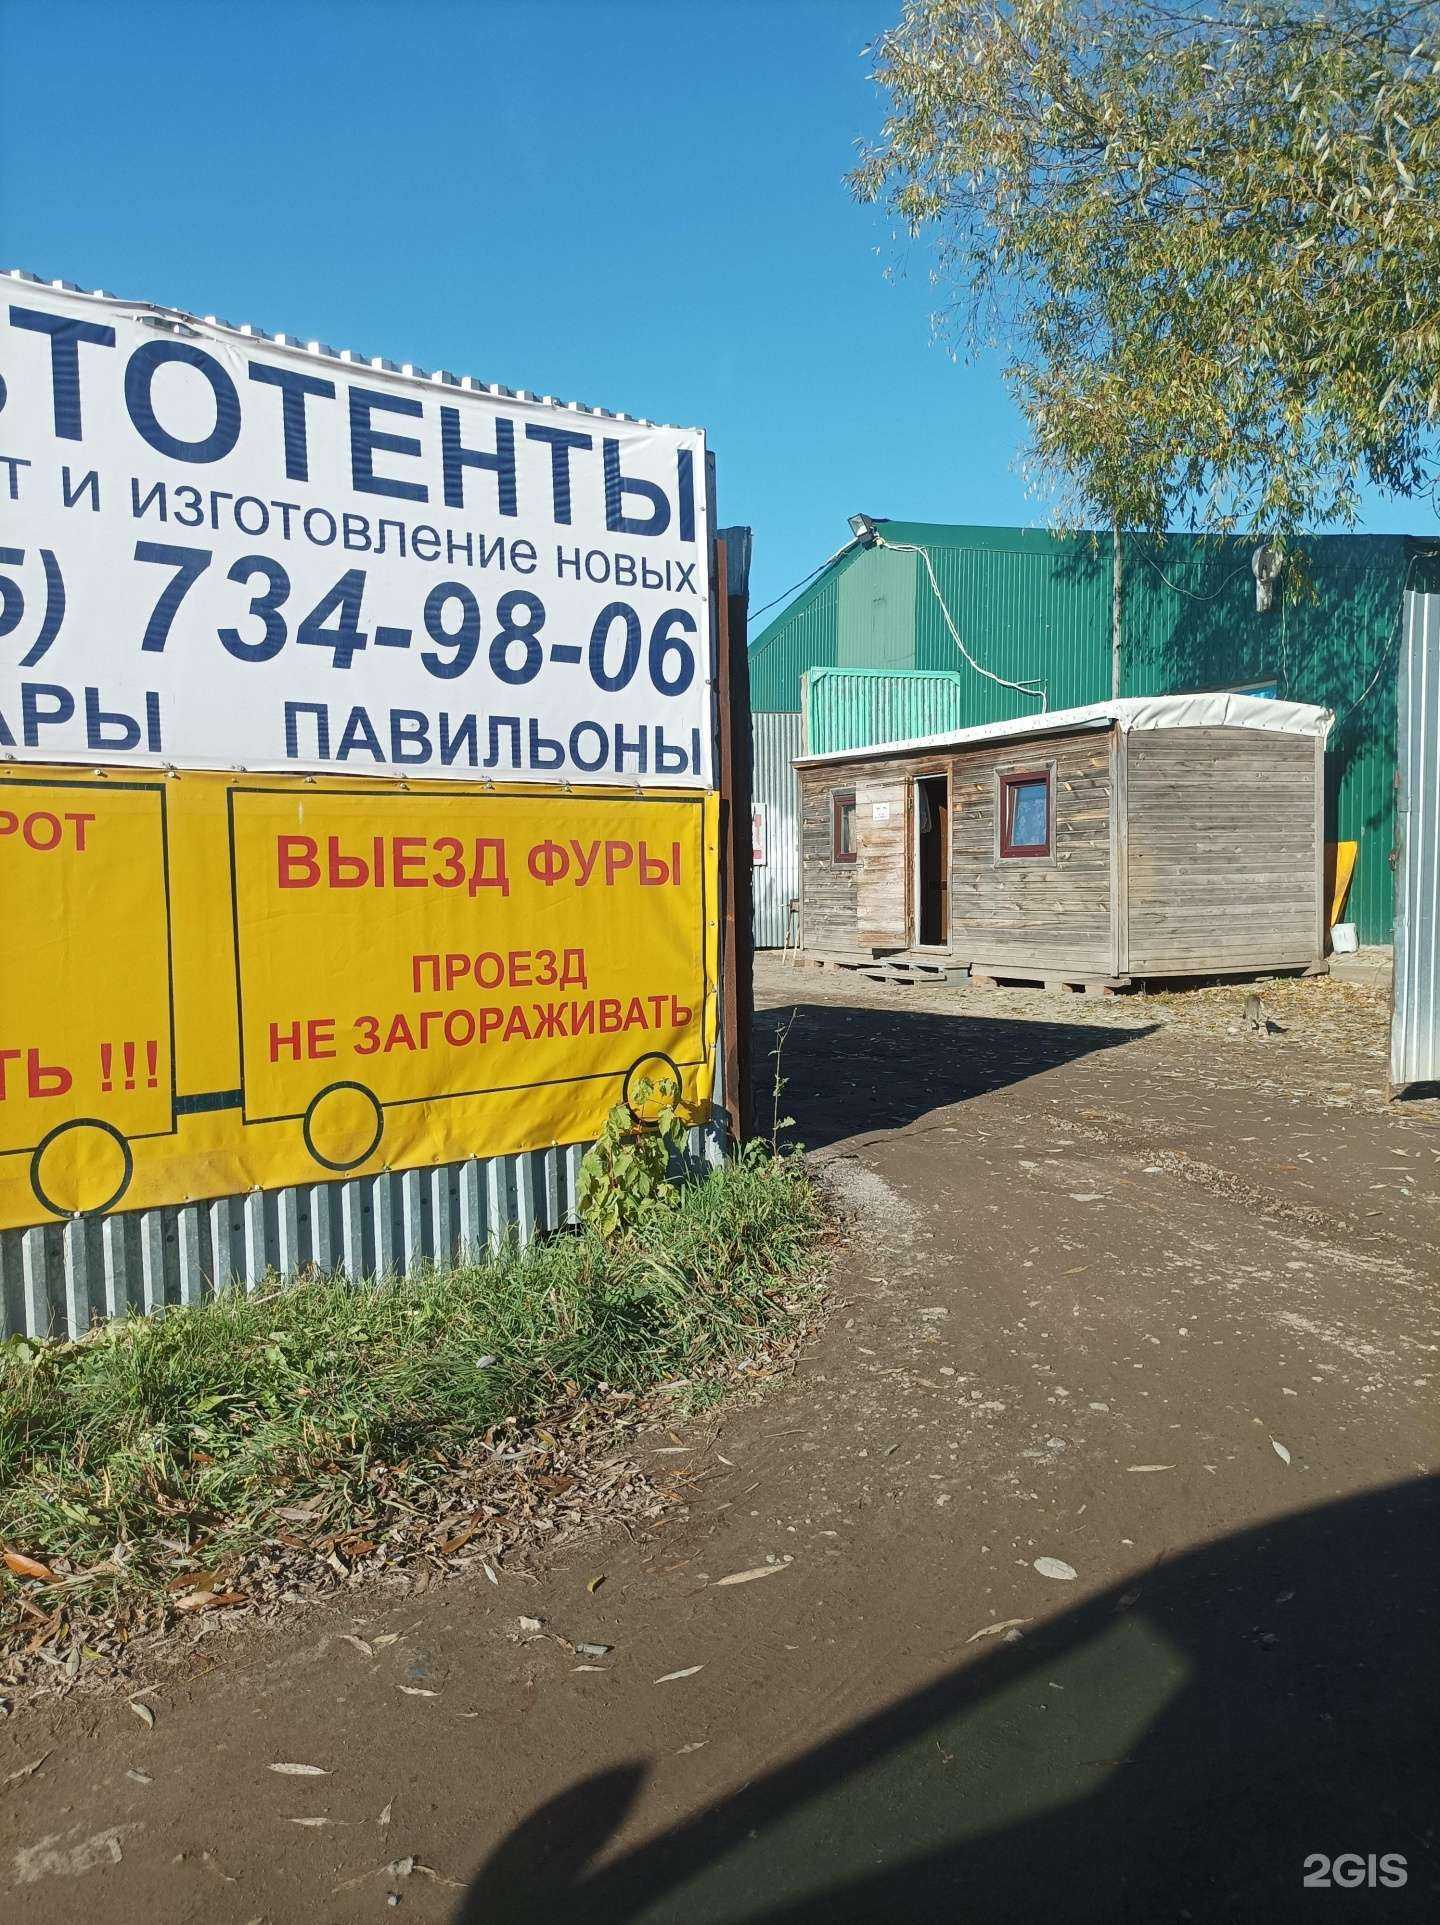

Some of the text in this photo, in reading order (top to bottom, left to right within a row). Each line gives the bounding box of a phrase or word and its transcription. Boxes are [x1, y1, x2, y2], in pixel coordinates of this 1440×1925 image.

[0, 305, 696, 543] ТОТЕНТЫ
[131, 477, 538, 575] изготовление
[556, 545, 698, 594] новых
[133, 540, 698, 697] 734-98-06
[0, 682, 701, 776] РЫ ПАВИЛЬОНЫ
[277, 834, 682, 897] ВЫЕЗД ФУРЫ
[412, 948, 588, 993] ПРОЕЗД
[268, 994, 693, 1063] НЕ ЗАГОРАЖИВАТЬ
